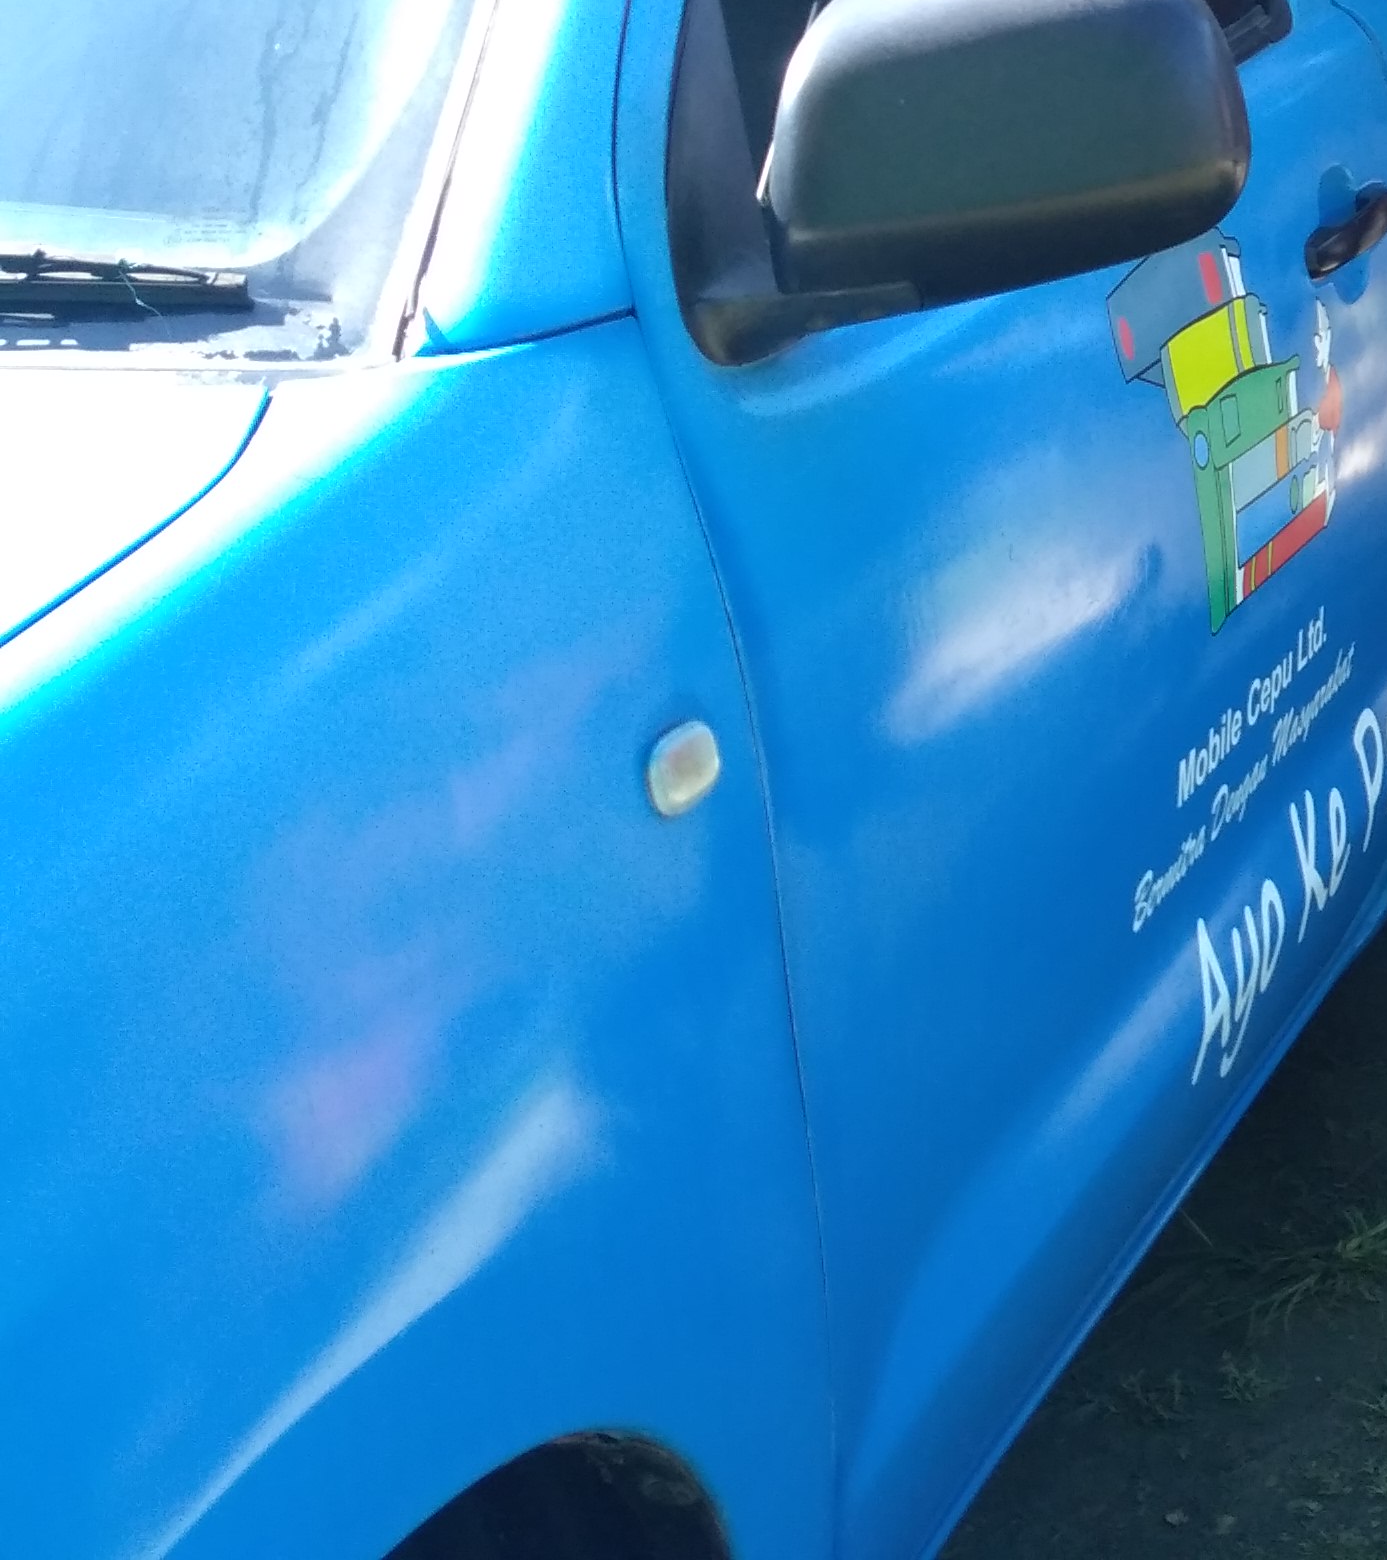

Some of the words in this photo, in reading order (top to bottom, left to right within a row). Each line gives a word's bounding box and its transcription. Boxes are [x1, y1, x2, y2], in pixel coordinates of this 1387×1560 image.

[1177, 707, 1243, 809] Mobile
[1247, 651, 1294, 726] Cepu
[1297, 605, 1328, 672] Ltd.
[1191, 916, 1286, 1085] Ayo
[1290, 787, 1351, 944] Ke
